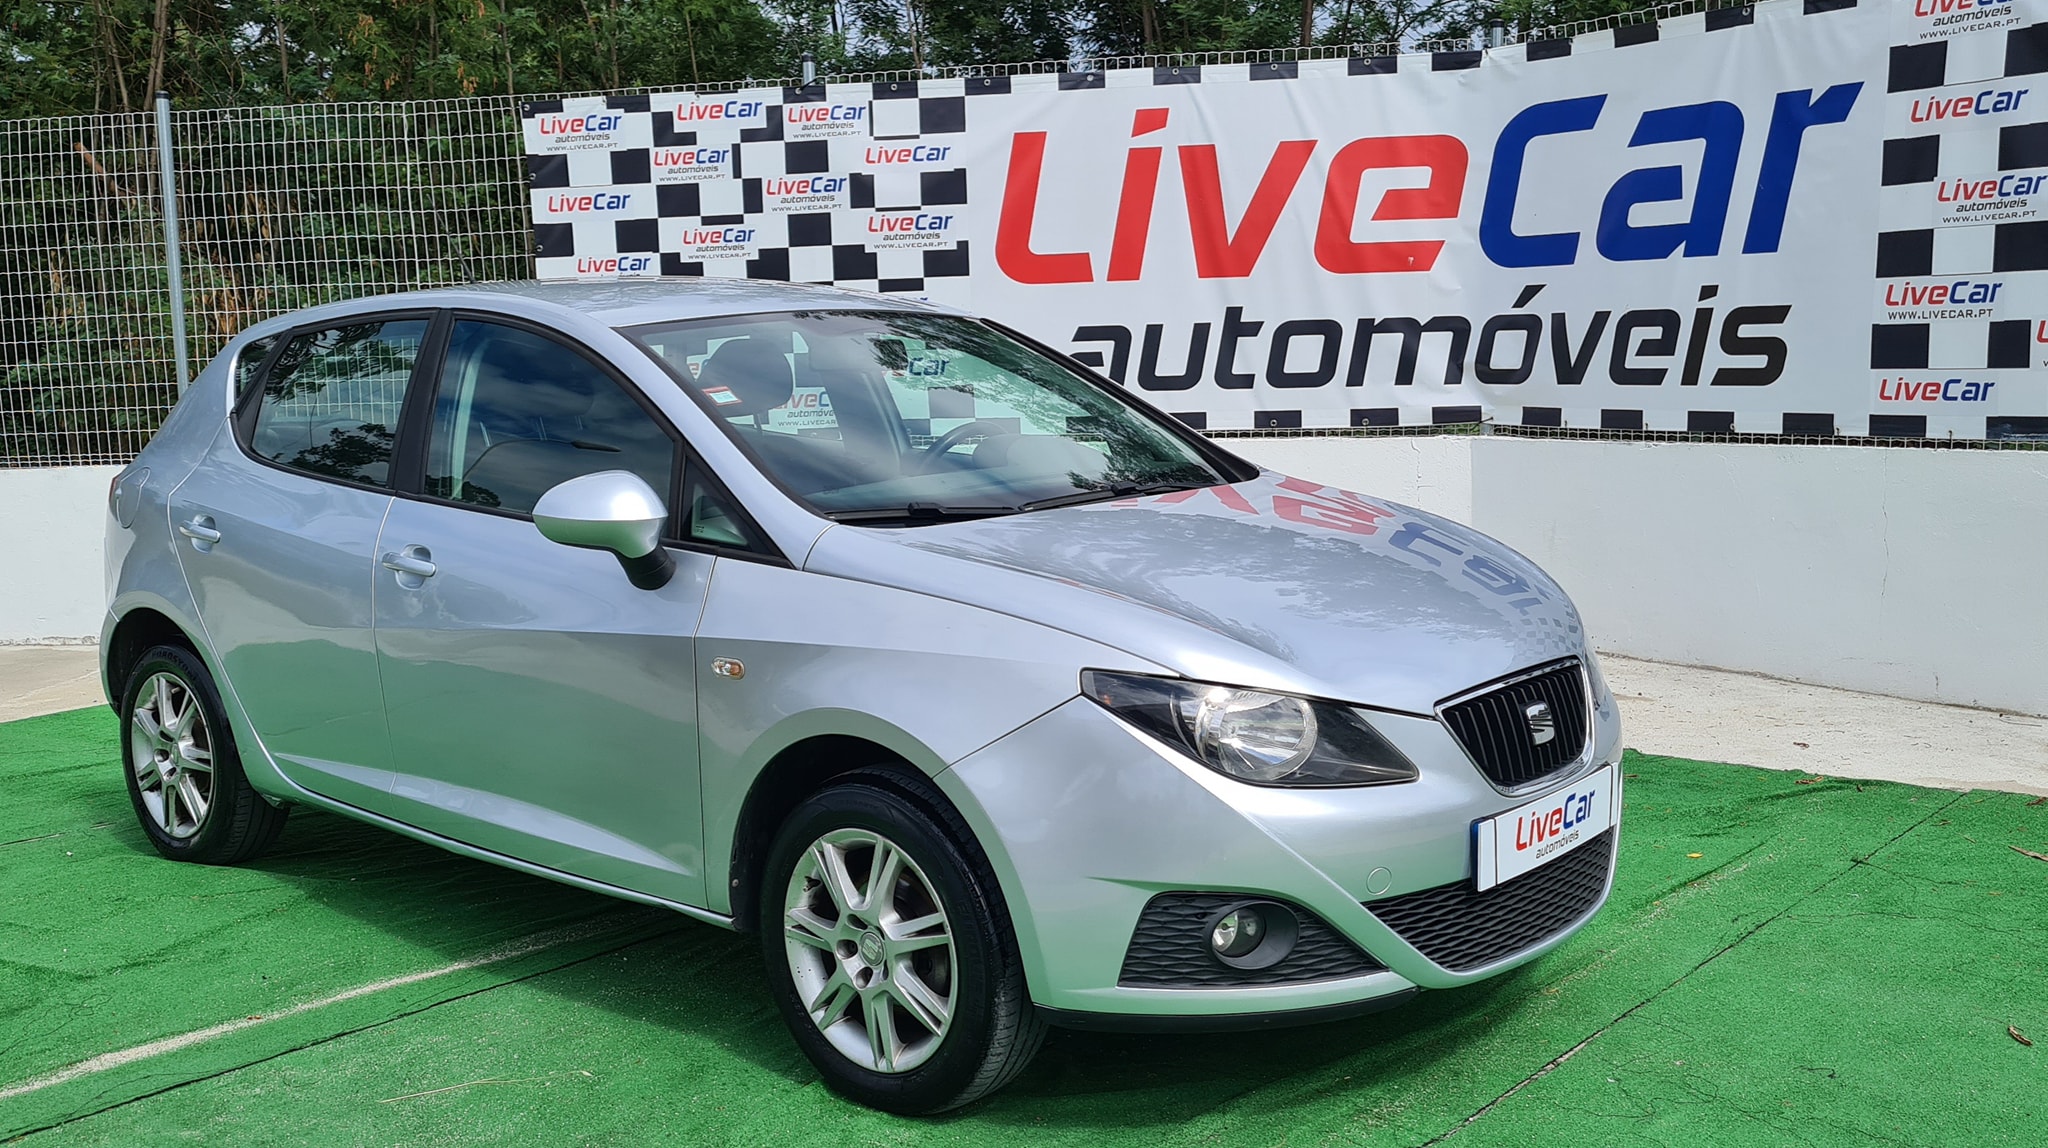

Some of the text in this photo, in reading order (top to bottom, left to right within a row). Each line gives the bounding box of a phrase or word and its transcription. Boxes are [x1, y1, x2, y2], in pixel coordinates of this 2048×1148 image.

[1932, 5, 2012, 26] automóveis
[677, 101, 763, 121] LiveCar
[788, 105, 867, 123] LiveCar
[1910, 89, 2029, 122] LiveCar
[540, 115, 622, 135] LiveCar
[801, 120, 855, 131] automóveis
[555, 132, 611, 144] automóveis
[654, 148, 730, 166] LiveCar
[865, 145, 951, 164] LiveCar
[667, 165, 719, 175] automóveis
[766, 176, 848, 195] LiveCar
[995, 81, 1865, 285] LiveCar
[1937, 175, 2048, 202] LiveCar
[548, 193, 631, 213] LiveCar
[780, 194, 836, 204] automóveis
[1956, 198, 2028, 213] automóveis
[868, 214, 954, 232] LiveCar
[683, 228, 756, 245] LiveCar
[882, 231, 941, 241] automóveis
[696, 243, 745, 252] automóveis
[577, 256, 651, 273] LiveCar
[1885, 281, 2003, 306] LiveCar
[1068, 284, 1792, 391] automóveis
[1879, 377, 1996, 402] LiveCar
[1516, 789, 1596, 851] LiveCar
[1536, 829, 1580, 859] automóveis
